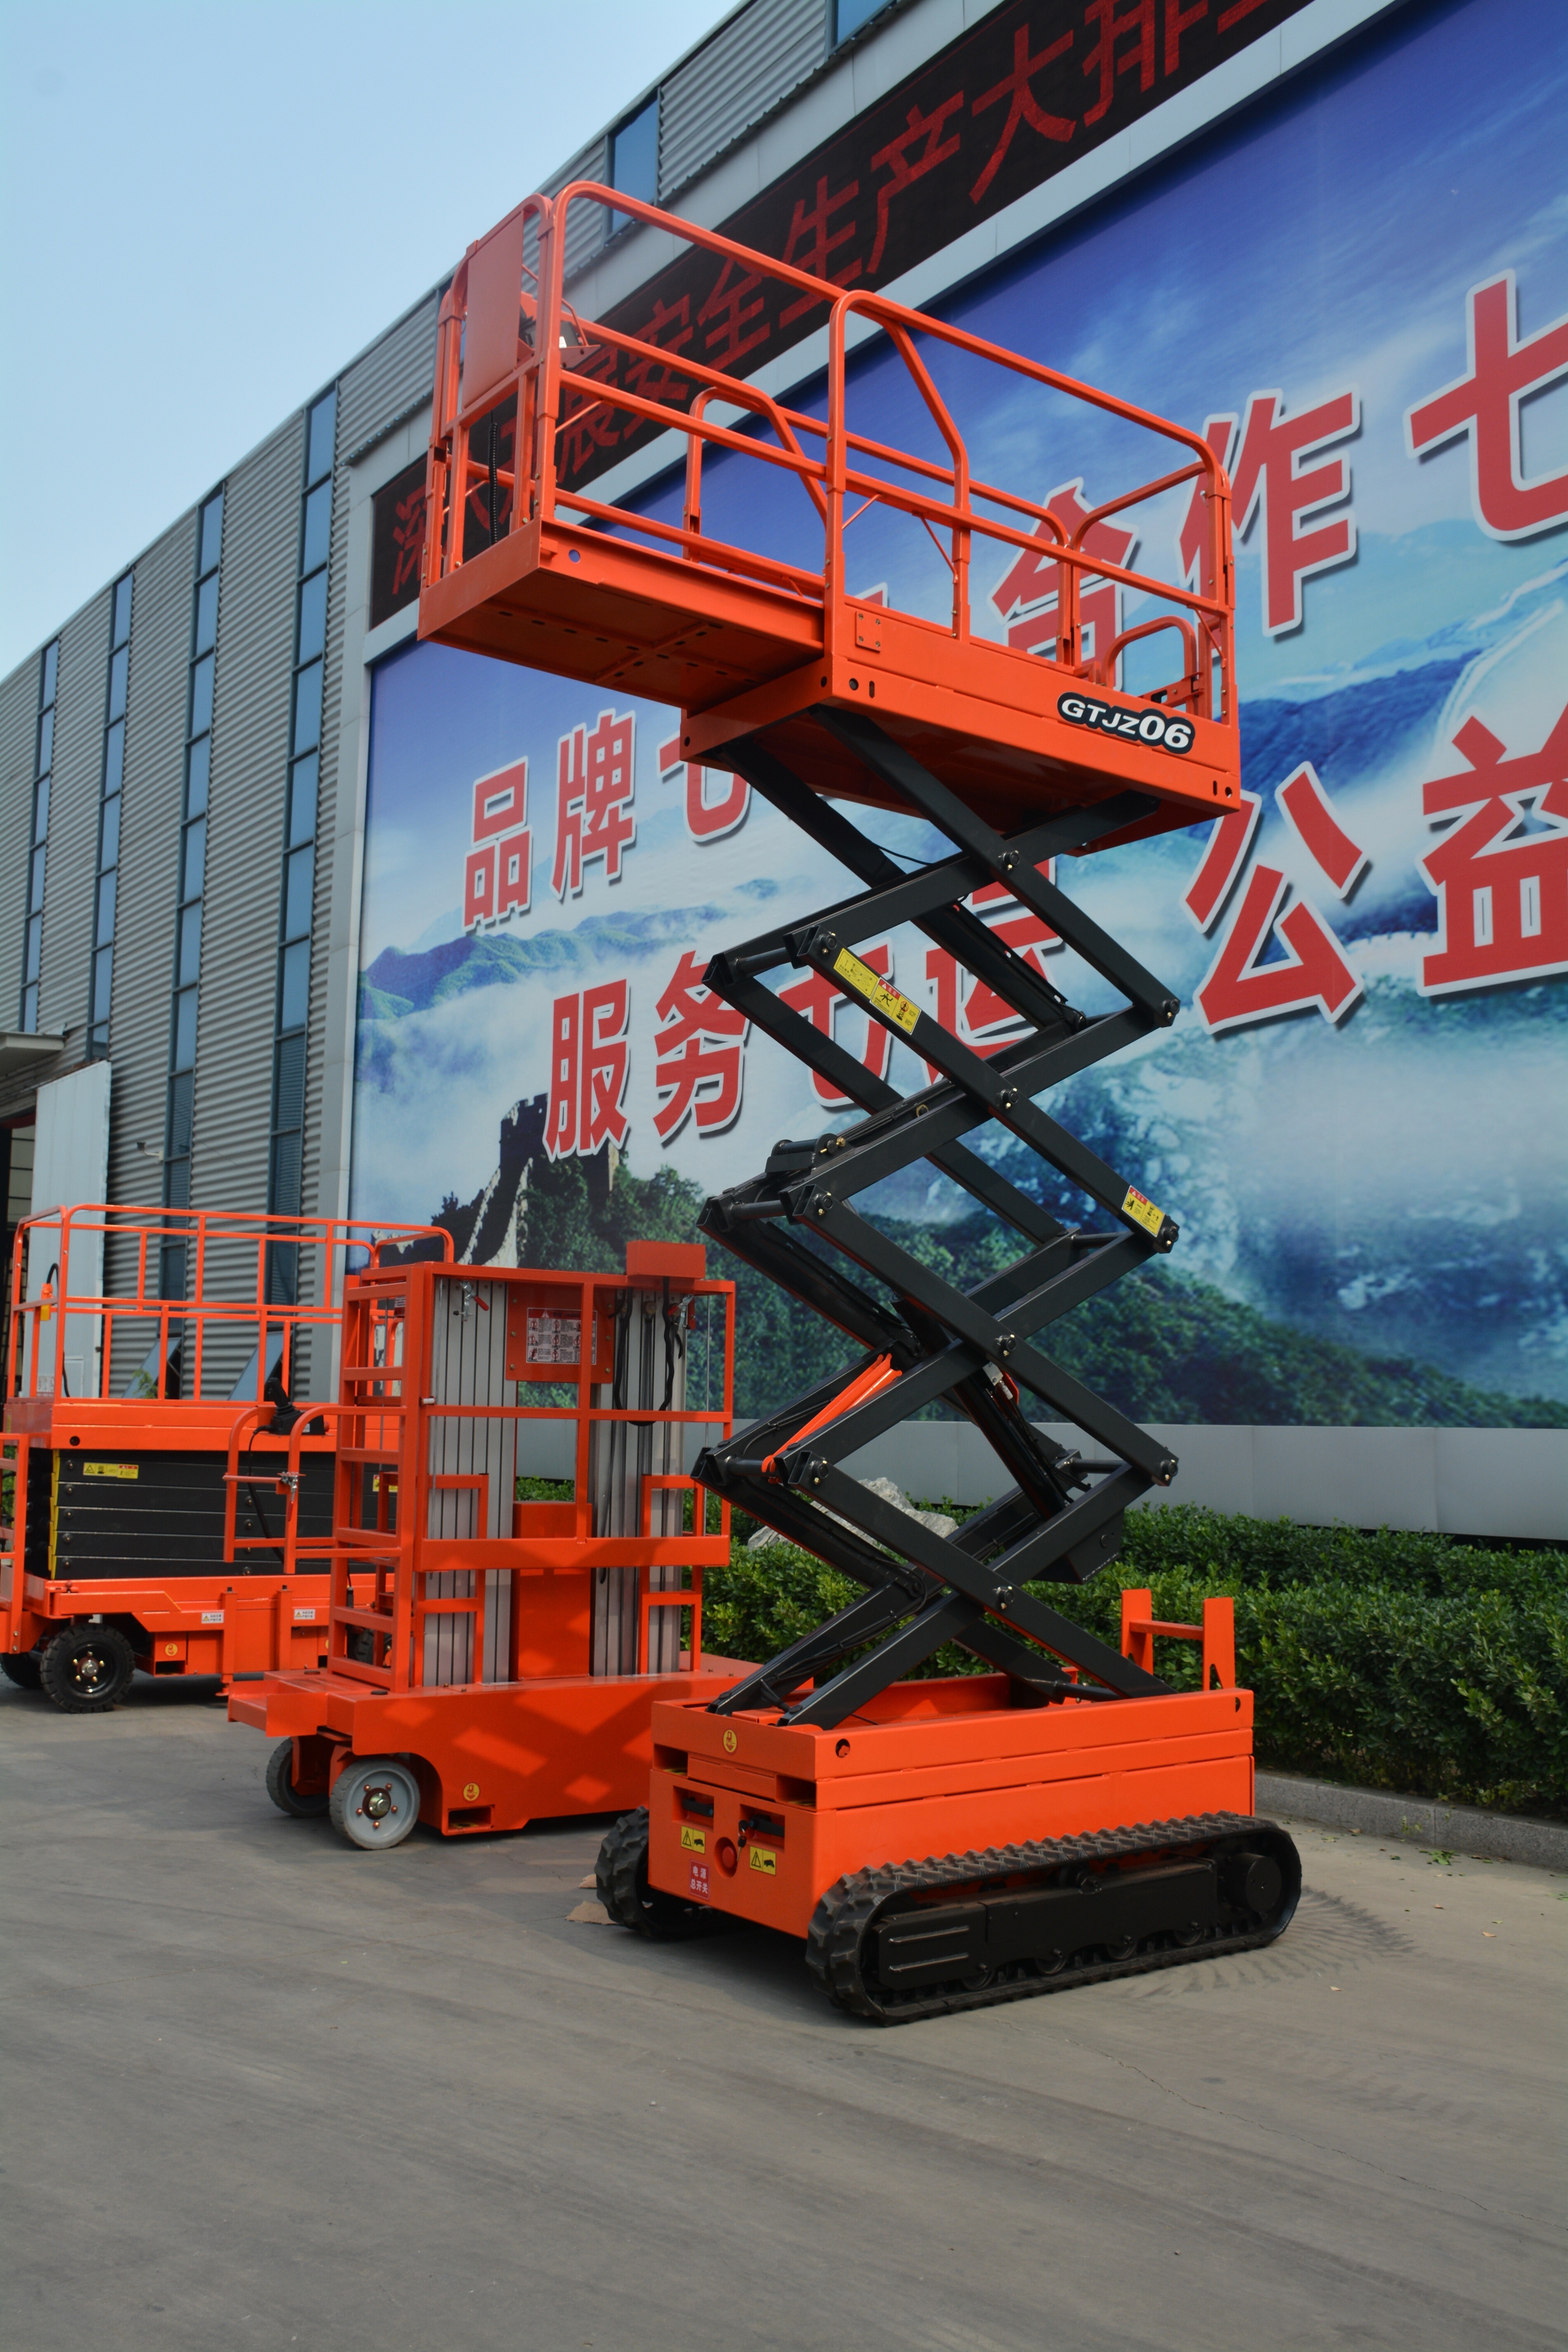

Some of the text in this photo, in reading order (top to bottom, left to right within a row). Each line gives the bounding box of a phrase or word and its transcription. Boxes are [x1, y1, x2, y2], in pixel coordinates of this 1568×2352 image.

[1061, 699, 1192, 749] GTJZ06
[1185, 702, 1568, 1026] 公益
[690, 1878, 708, 1894] 总开关
[693, 1866, 706, 1879] 电源
